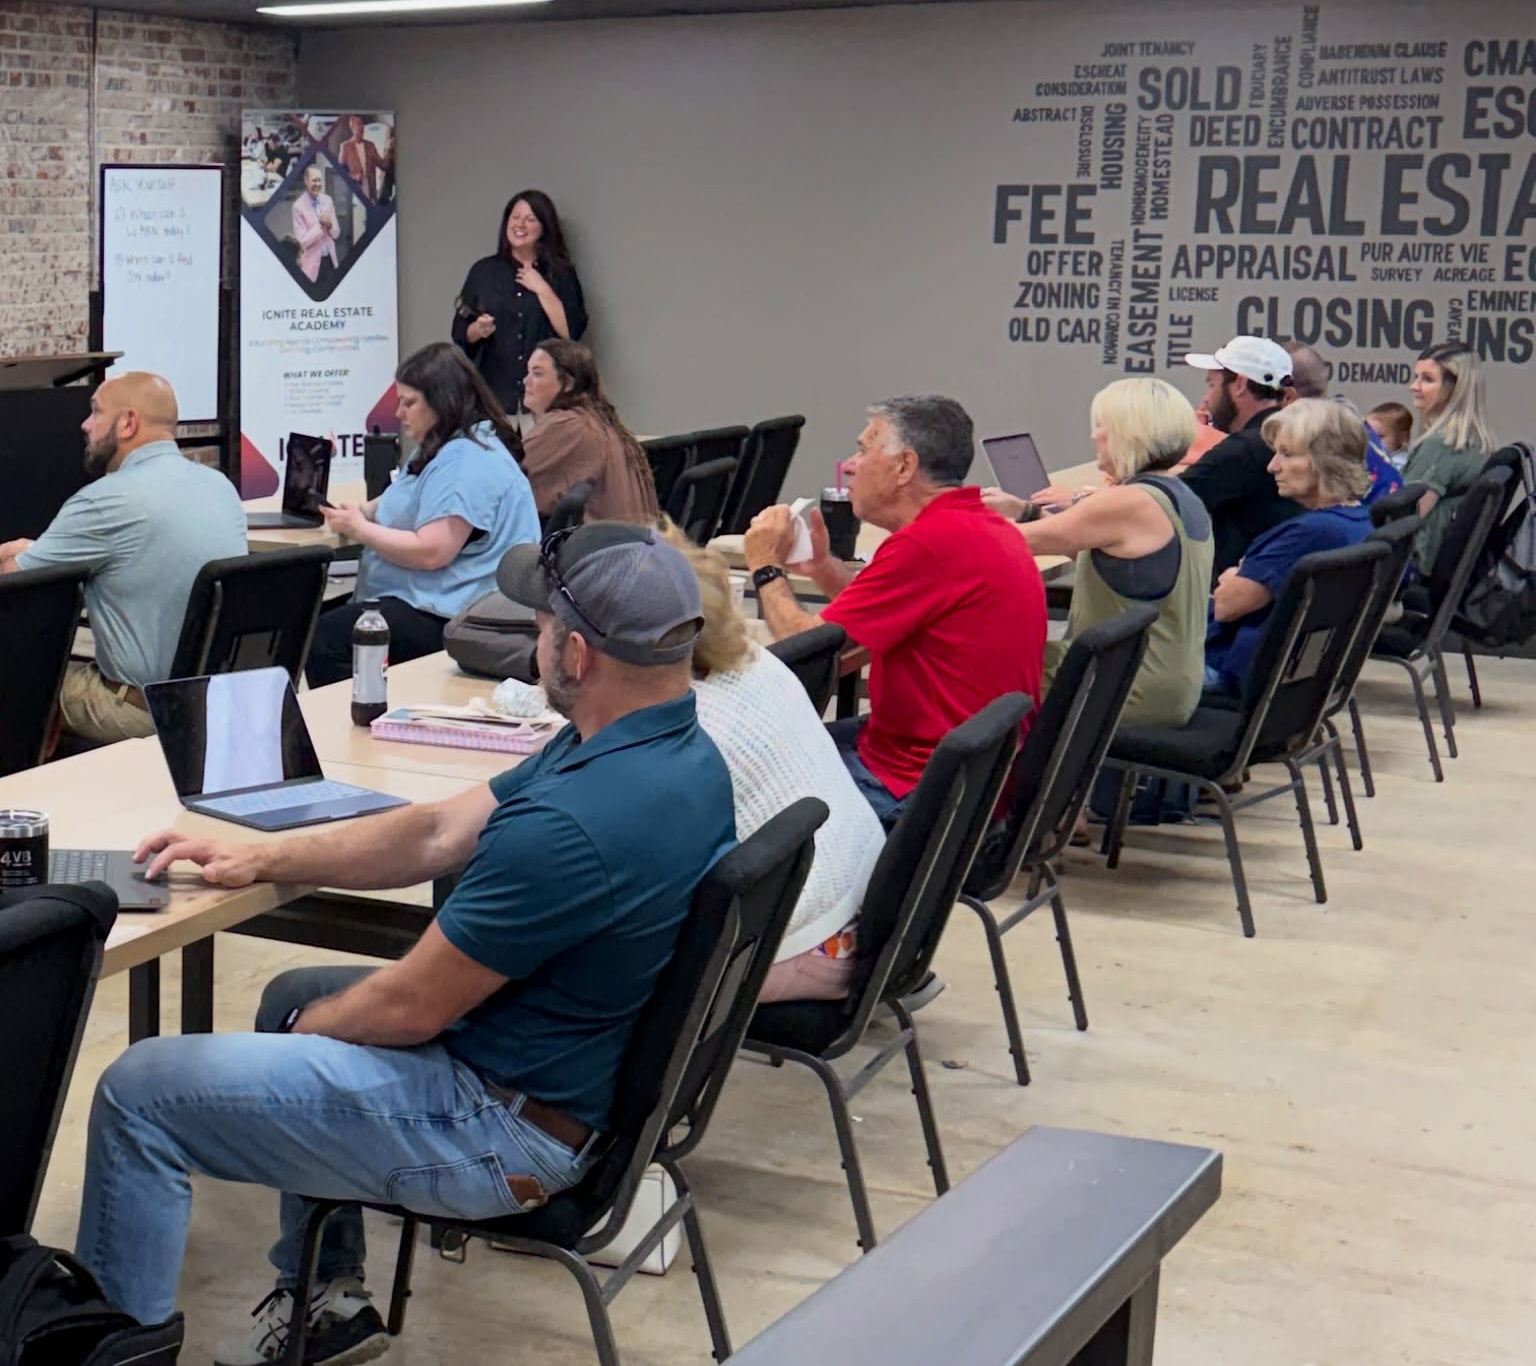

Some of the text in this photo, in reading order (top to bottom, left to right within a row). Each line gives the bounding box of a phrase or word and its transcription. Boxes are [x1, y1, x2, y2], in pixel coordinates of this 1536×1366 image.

[1101, 41, 1196, 57] JOINT TENANCY
[1298, 4, 1319, 88] COMPLIANCE
[1394, 42, 1448, 58] CLAUSE
[1464, 39, 1536, 76] CMA
[1074, 64, 1127, 78] ESCHEAT
[1249, 43, 1267, 109] FIDUCIARY
[1317, 67, 1444, 85] ANTITRUST LAWS
[1035, 82, 1127, 97] CONSIDERATION
[1137, 66, 1242, 111] SOLD
[1267, 35, 1292, 149] ENCUMBRANCE
[1296, 94, 1440, 111] ADVERSE POSSESSION
[1012, 107, 1077, 122] ABSTRACT
[1189, 114, 1262, 147] DEED
[1077, 106, 1094, 178] DISCLOSURE
[1100, 103, 1127, 189] HOUSING
[1291, 116, 1444, 150] CONTRACT
[1149, 114, 1174, 220] HOMESTEAD
[1194, 153, 1536, 236] REAL ESTA
[993, 185, 1097, 244] FEE
[1027, 250, 1103, 276] OFFER
[1171, 244, 1356, 281] APPRAISAL
[1361, 242, 1489, 263] PUR AUTRE VIE
[1371, 267, 1423, 282] SURVEY
[1433, 268, 1496, 282] ACREAGE
[1014, 282, 1100, 309] ZONING
[1102, 240, 1125, 365] TENANCY IN COMMON
[1124, 228, 1163, 373] EASEMENT
[1169, 287, 1218, 301] LICENSE
[263, 307, 373, 320] IGNITE REAL ESTATE
[290, 320, 346, 331] ACADEMY
[1009, 317, 1101, 343] OLD CAR
[1237, 296, 1434, 350] CLOSING
[1166, 314, 1193, 368] TITLE
[1466, 317, 1535, 363] INS
[1338, 362, 1411, 384] DEMAND
